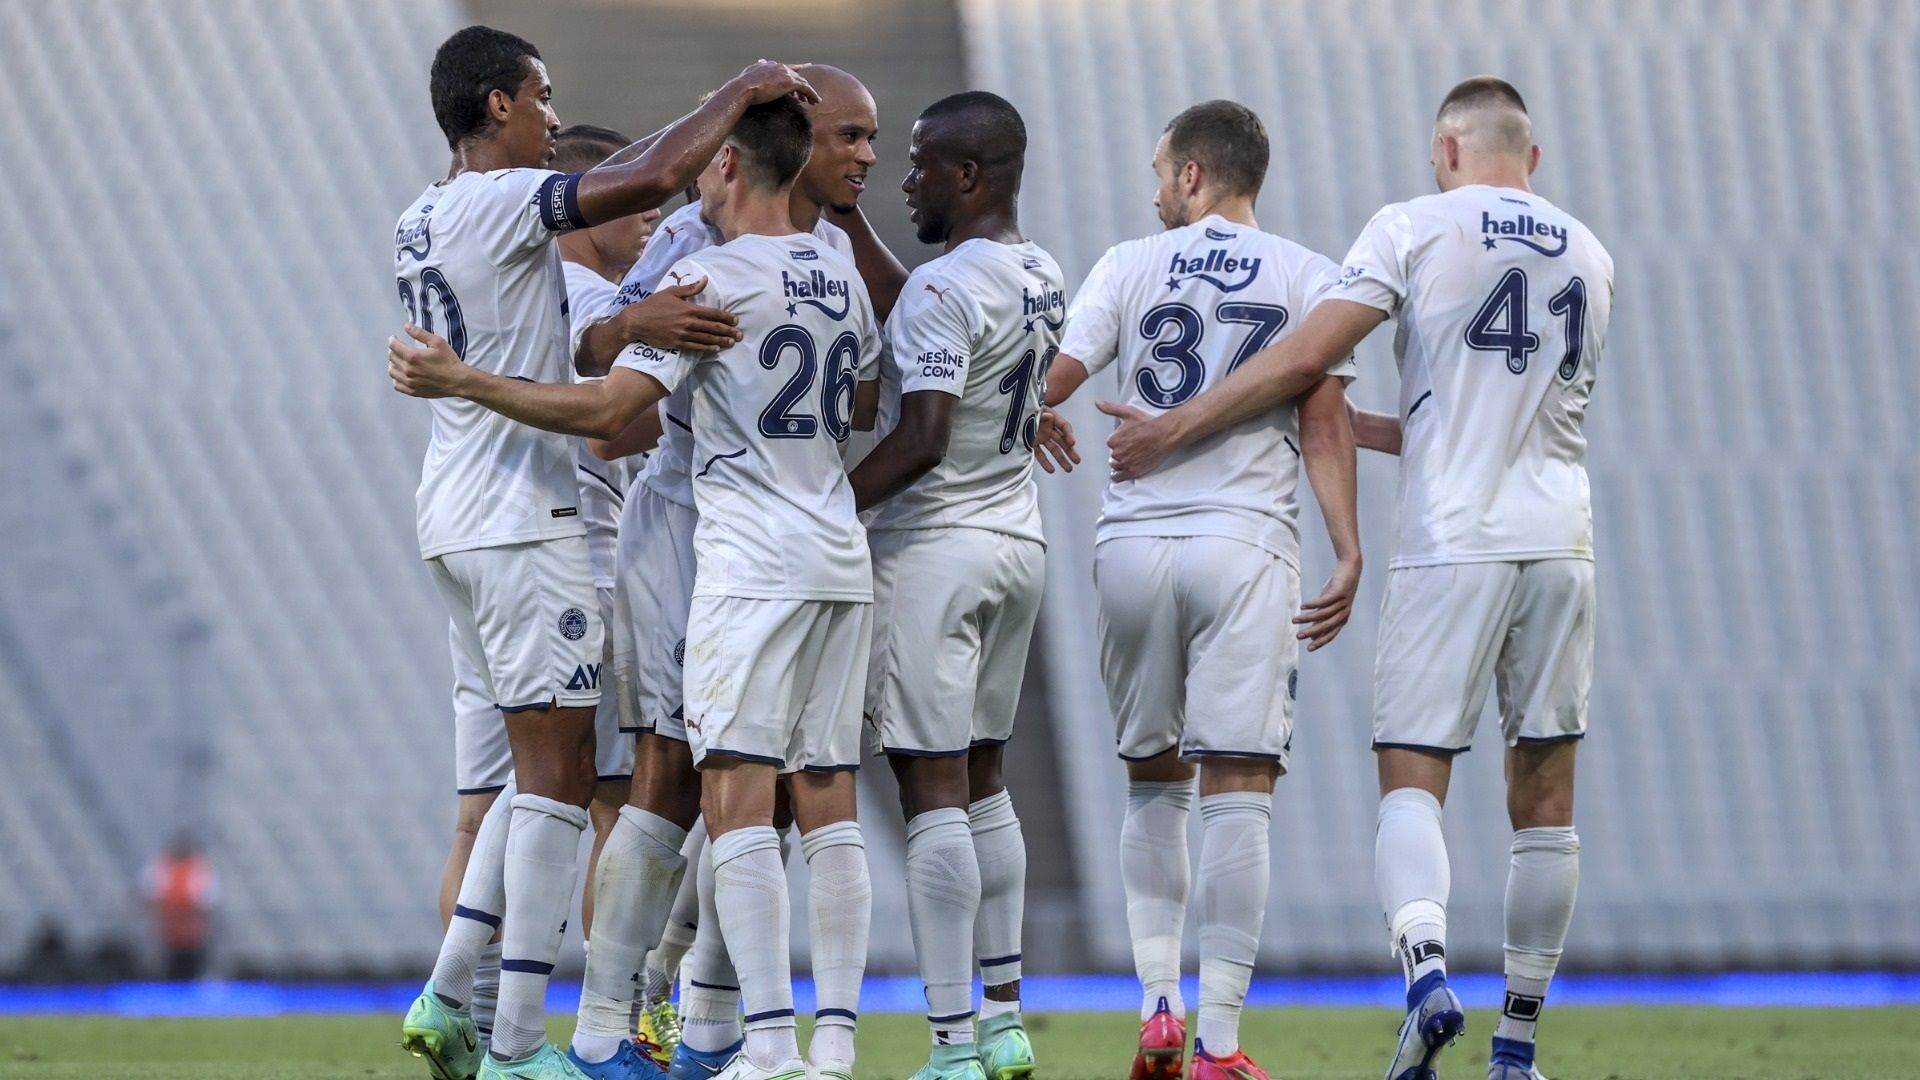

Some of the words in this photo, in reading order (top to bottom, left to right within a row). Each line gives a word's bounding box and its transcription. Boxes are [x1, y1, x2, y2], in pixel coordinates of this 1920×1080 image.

[554, 180, 566, 220] RESPECT
[1482, 211, 1567, 257] halley
[1168, 249, 1262, 293] halley
[781, 269, 850, 321] halley
[1023, 282, 1066, 331] halley
[1465, 267, 1588, 381] 41
[628, 345, 665, 362] .COM
[920, 366, 955, 380] .COM
[1136, 302, 1288, 409] 37
[758, 324, 860, 442] 26
[564, 663, 603, 690] AY
